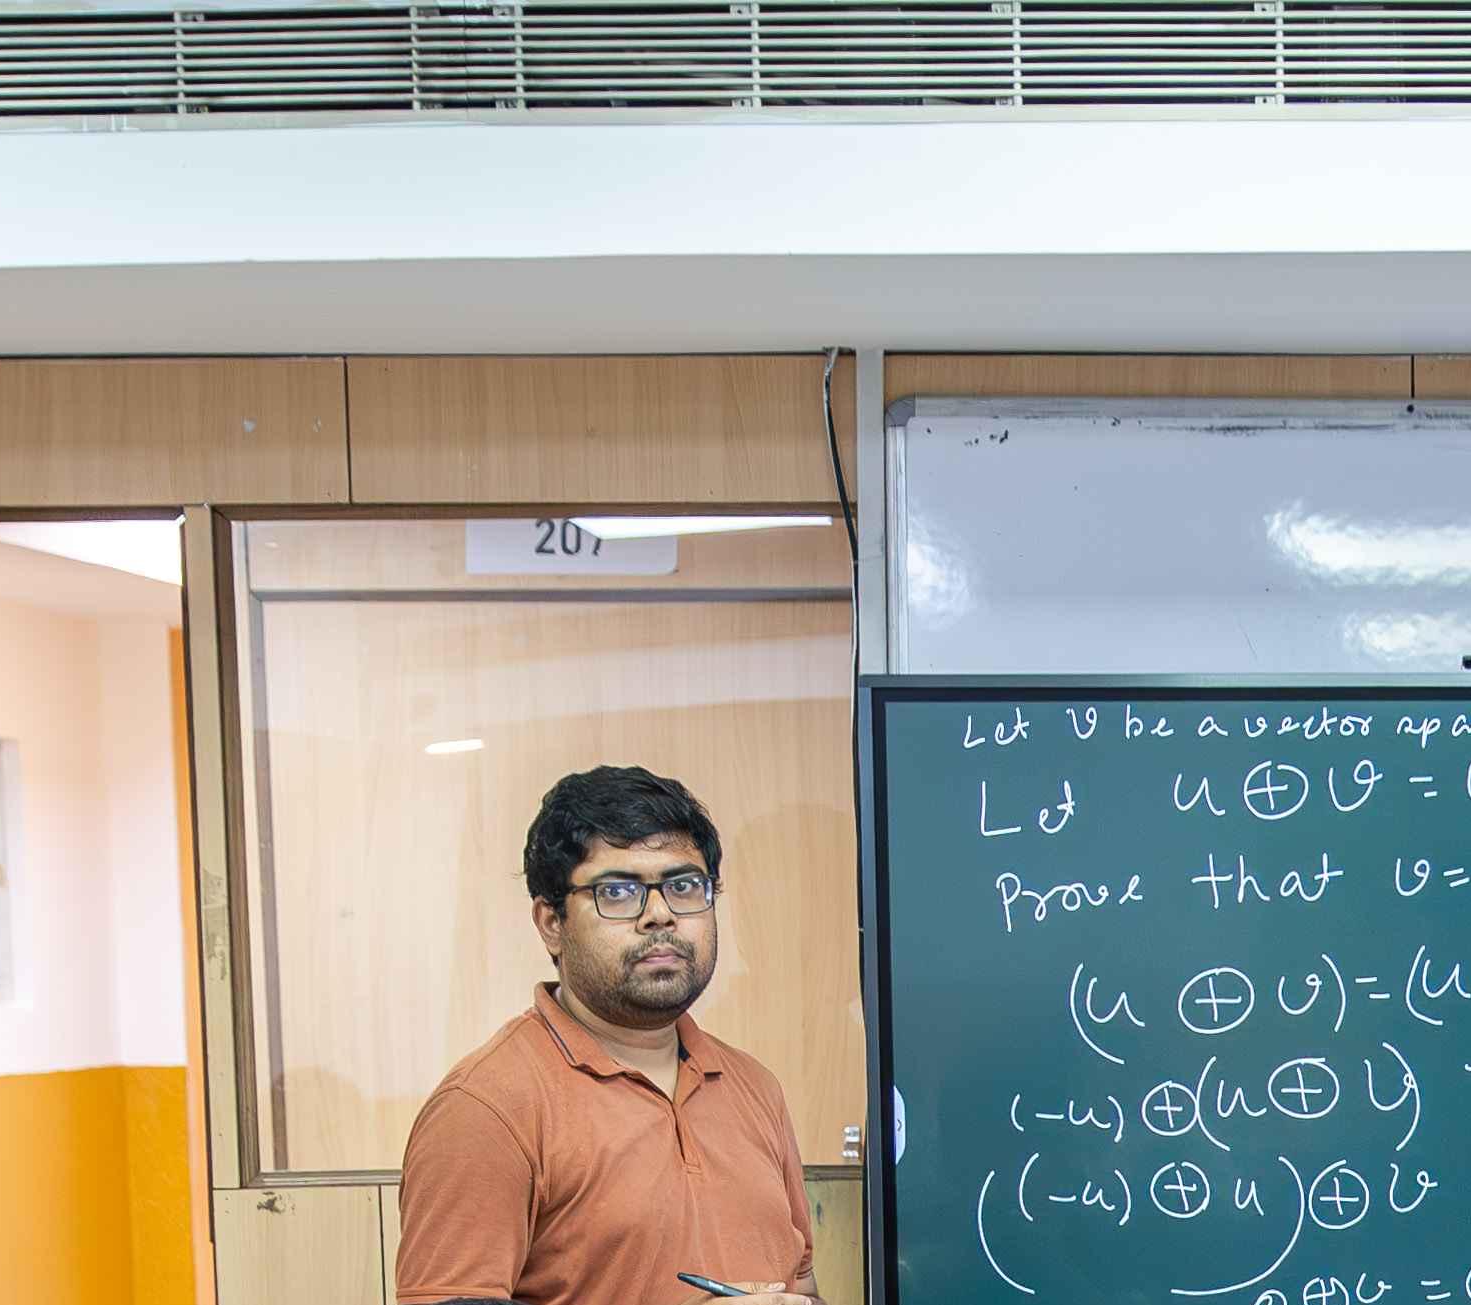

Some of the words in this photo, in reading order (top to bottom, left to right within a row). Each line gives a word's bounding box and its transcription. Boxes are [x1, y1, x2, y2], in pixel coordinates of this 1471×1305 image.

[963, 707, 1030, 749] Let
[1125, 703, 1175, 740] be
[1243, 706, 1373, 741] vector
[980, 780, 1075, 836] Let
[1191, 853, 1344, 909] that
